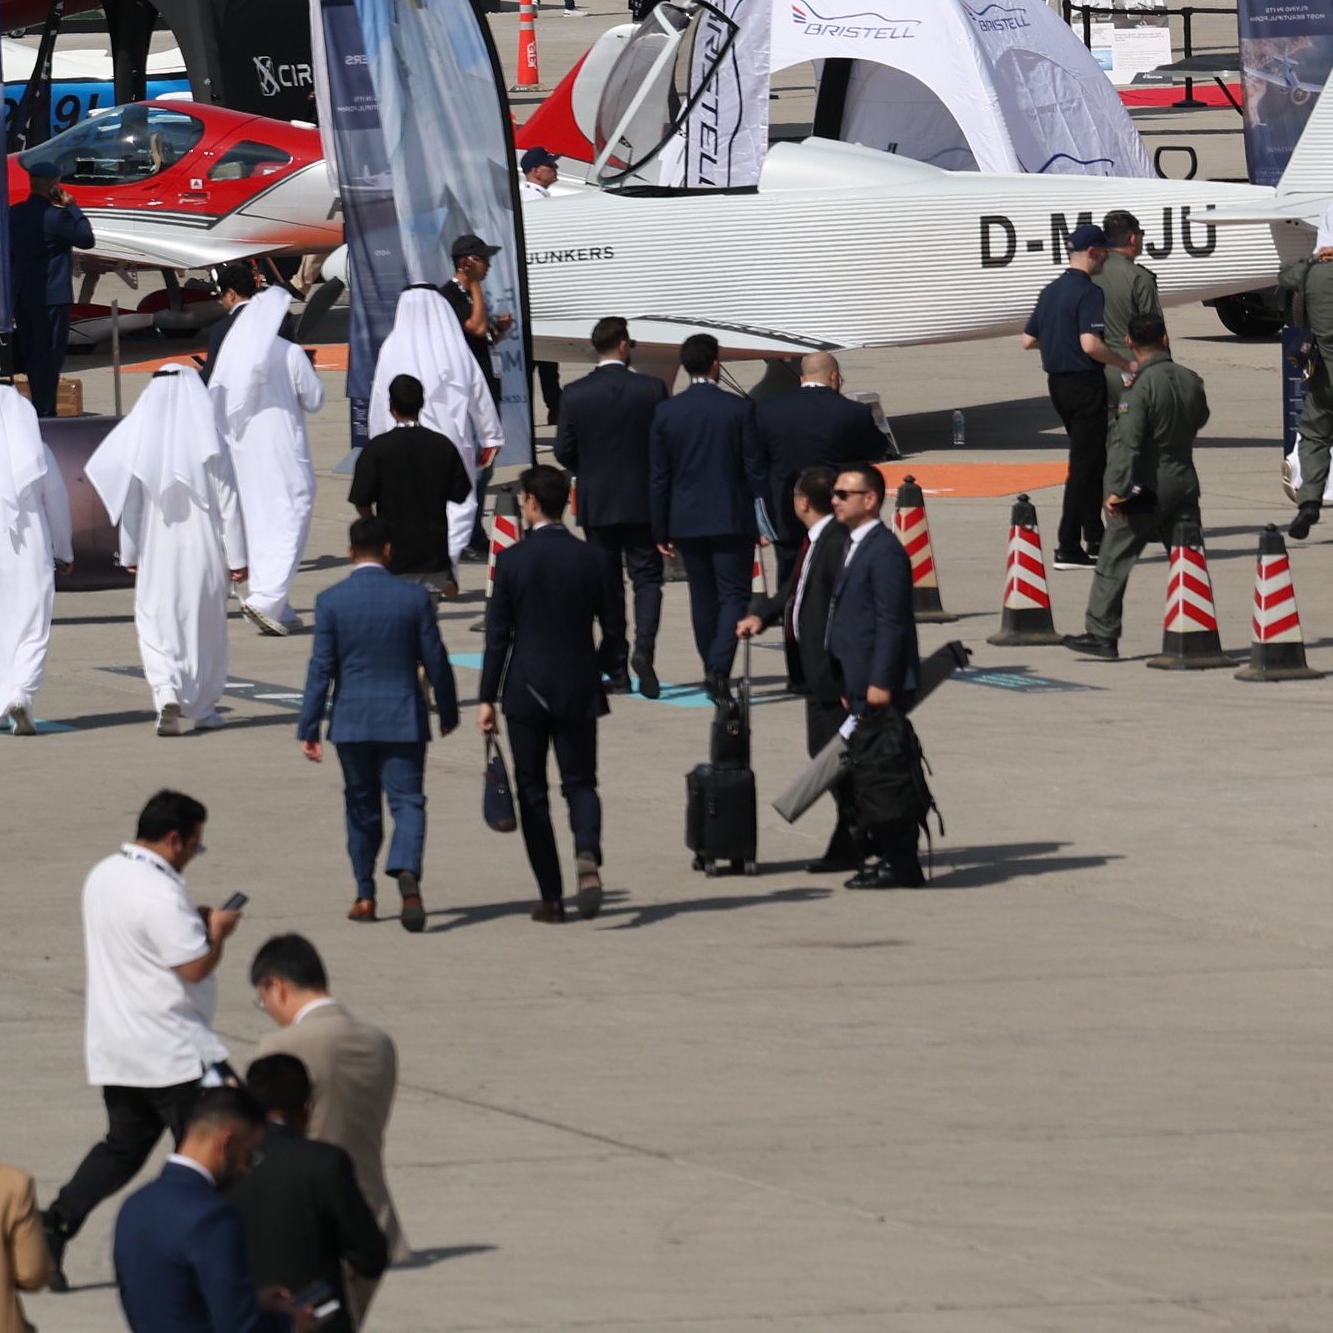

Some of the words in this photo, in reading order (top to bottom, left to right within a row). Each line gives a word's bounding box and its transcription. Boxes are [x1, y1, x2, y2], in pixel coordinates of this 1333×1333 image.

[803, 24, 917, 40] BRISTELL
[978, 13, 1032, 33] BRISTELL
[278, 63, 313, 87] CIR
[527, 246, 614, 265] JUNKERS
